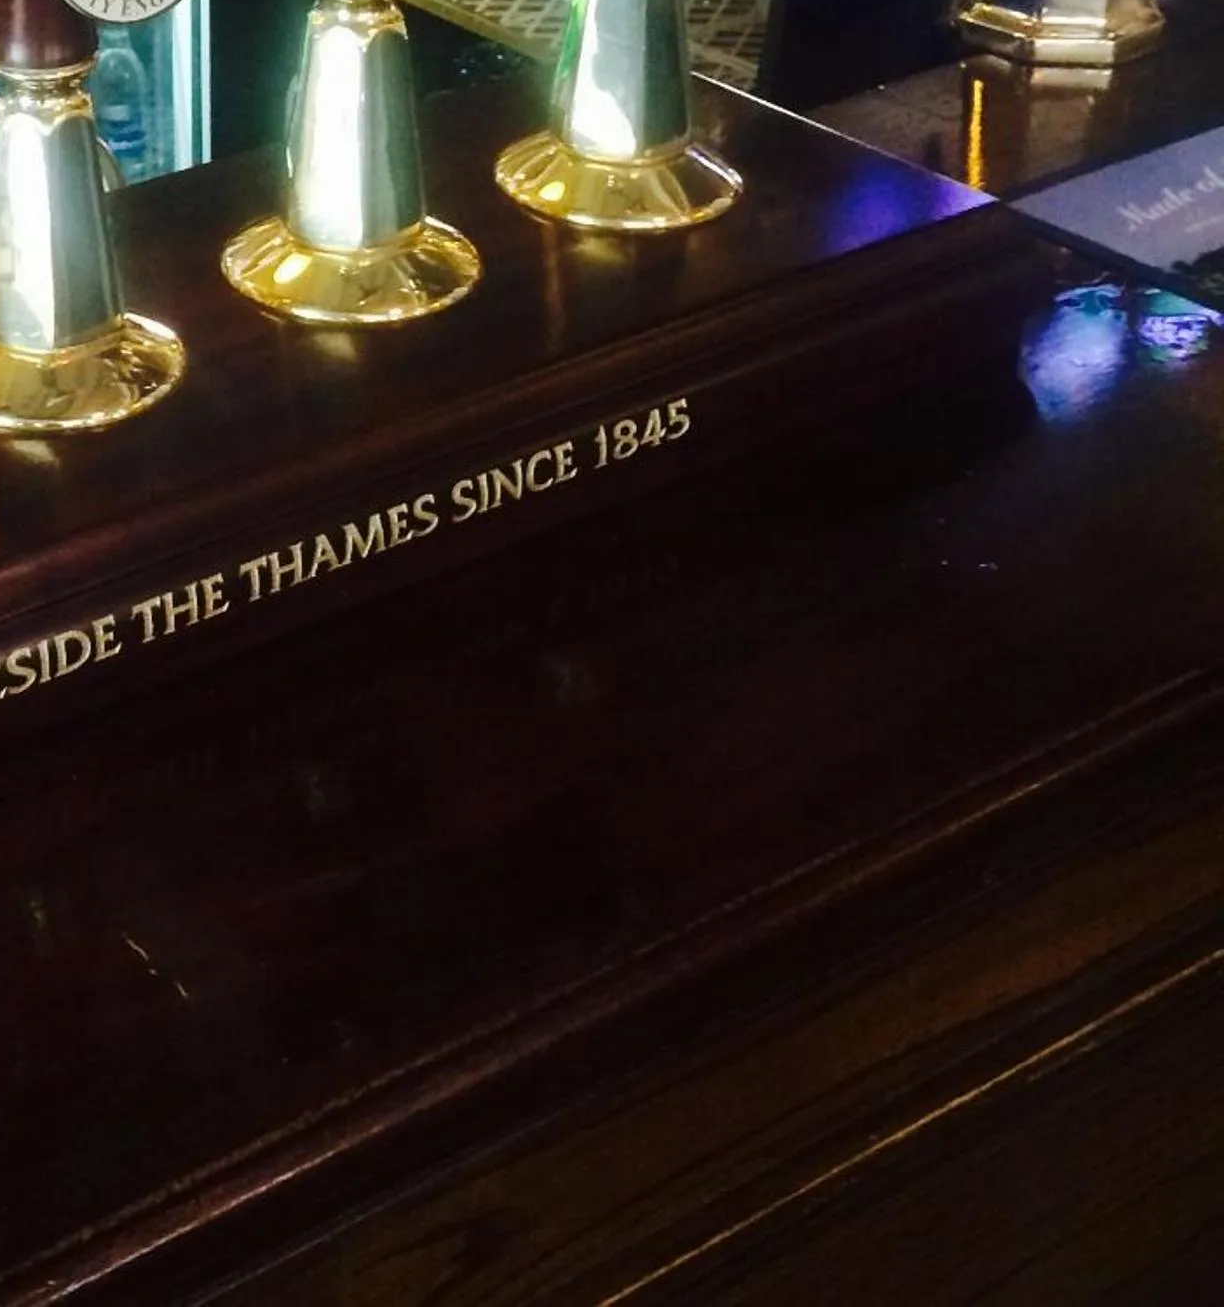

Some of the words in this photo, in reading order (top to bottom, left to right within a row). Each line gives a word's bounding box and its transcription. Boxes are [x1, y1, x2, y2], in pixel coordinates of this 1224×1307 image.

[131, 576, 230, 646] THE
[238, 493, 439, 604] THAMES
[452, 440, 578, 524] SINCE
[591, 398, 692, 470] 1845
